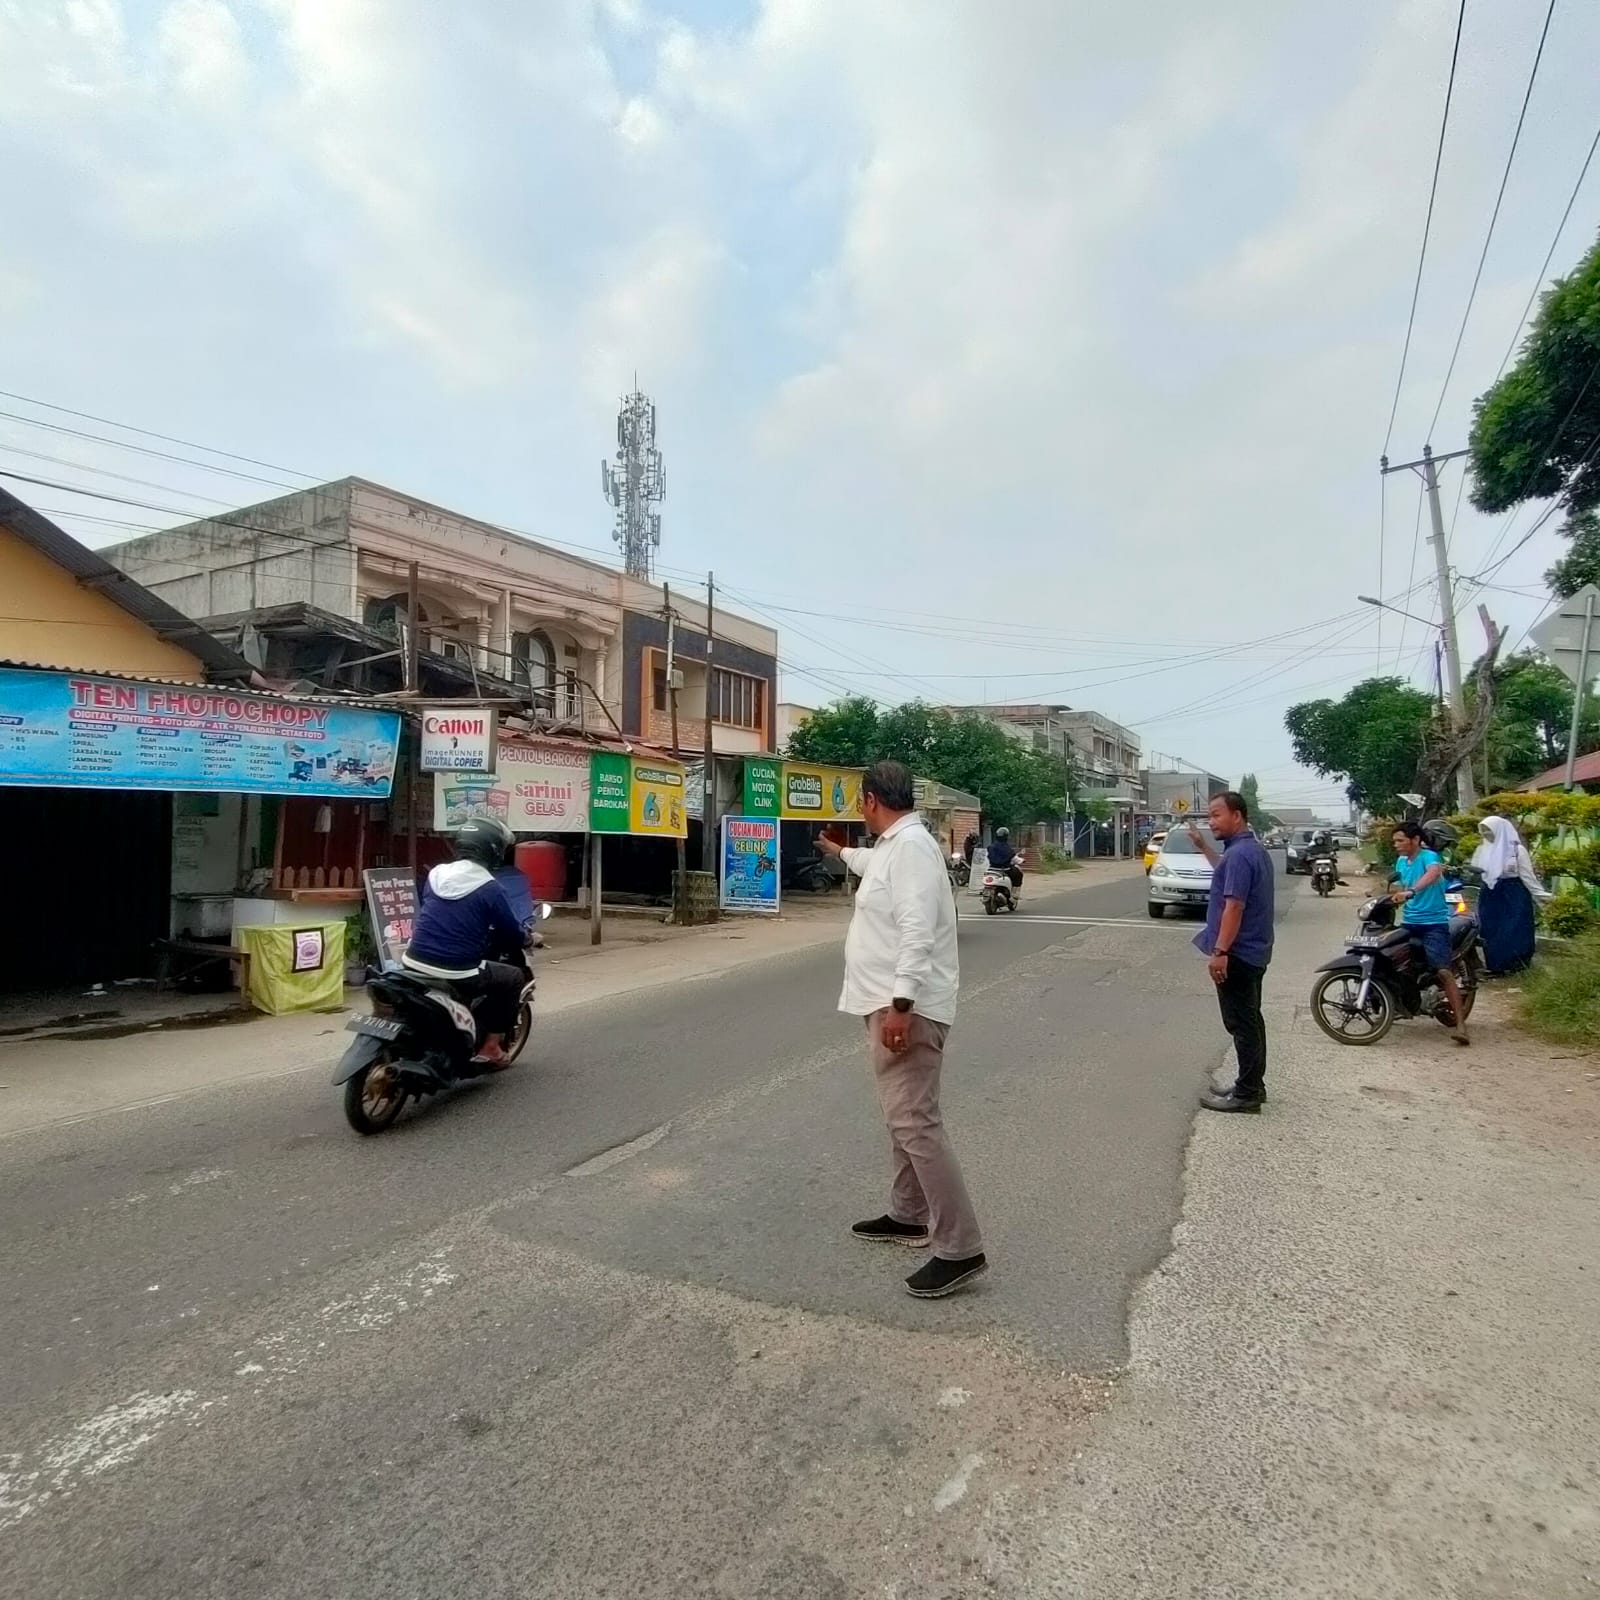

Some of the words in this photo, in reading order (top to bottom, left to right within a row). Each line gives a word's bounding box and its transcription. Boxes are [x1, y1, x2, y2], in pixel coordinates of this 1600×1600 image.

[69, 679, 137, 711] TEN
[147, 688, 329, 730] FHOTOCHOPY
[74, 710, 112, 721] DIGITAL
[112, 713, 153, 725] PRINTING
[161, 717, 182, 727] FOTO
[183, 720, 206, 729] COPY
[212, 722, 229, 731] ATK
[281, 728, 302, 738] CETAK
[303, 730, 323, 740] FOTO
[424, 716, 484, 736] Canon
[425, 757, 452, 766] DIGITAL
[454, 757, 483, 768] COPIER
[500, 746, 541, 764] PENTOL
[543, 751, 591, 769] BAROKAH
[599, 773, 623, 784] BAKSO
[637, 769, 666, 783] GrabBike
[752, 768, 776, 779] CUCIAN
[752, 782, 775, 794] MOTOR
[788, 776, 822, 792] GrabBike
[597, 786, 625, 797] PENTOL
[524, 801, 566, 816] GELAS
[593, 799, 629, 809] BAROKAH
[728, 822, 751, 837] CUCIAN
[752, 823, 775, 839] MOTOR
[734, 839, 768, 854] CELINK
[382, 904, 395, 916] Es
